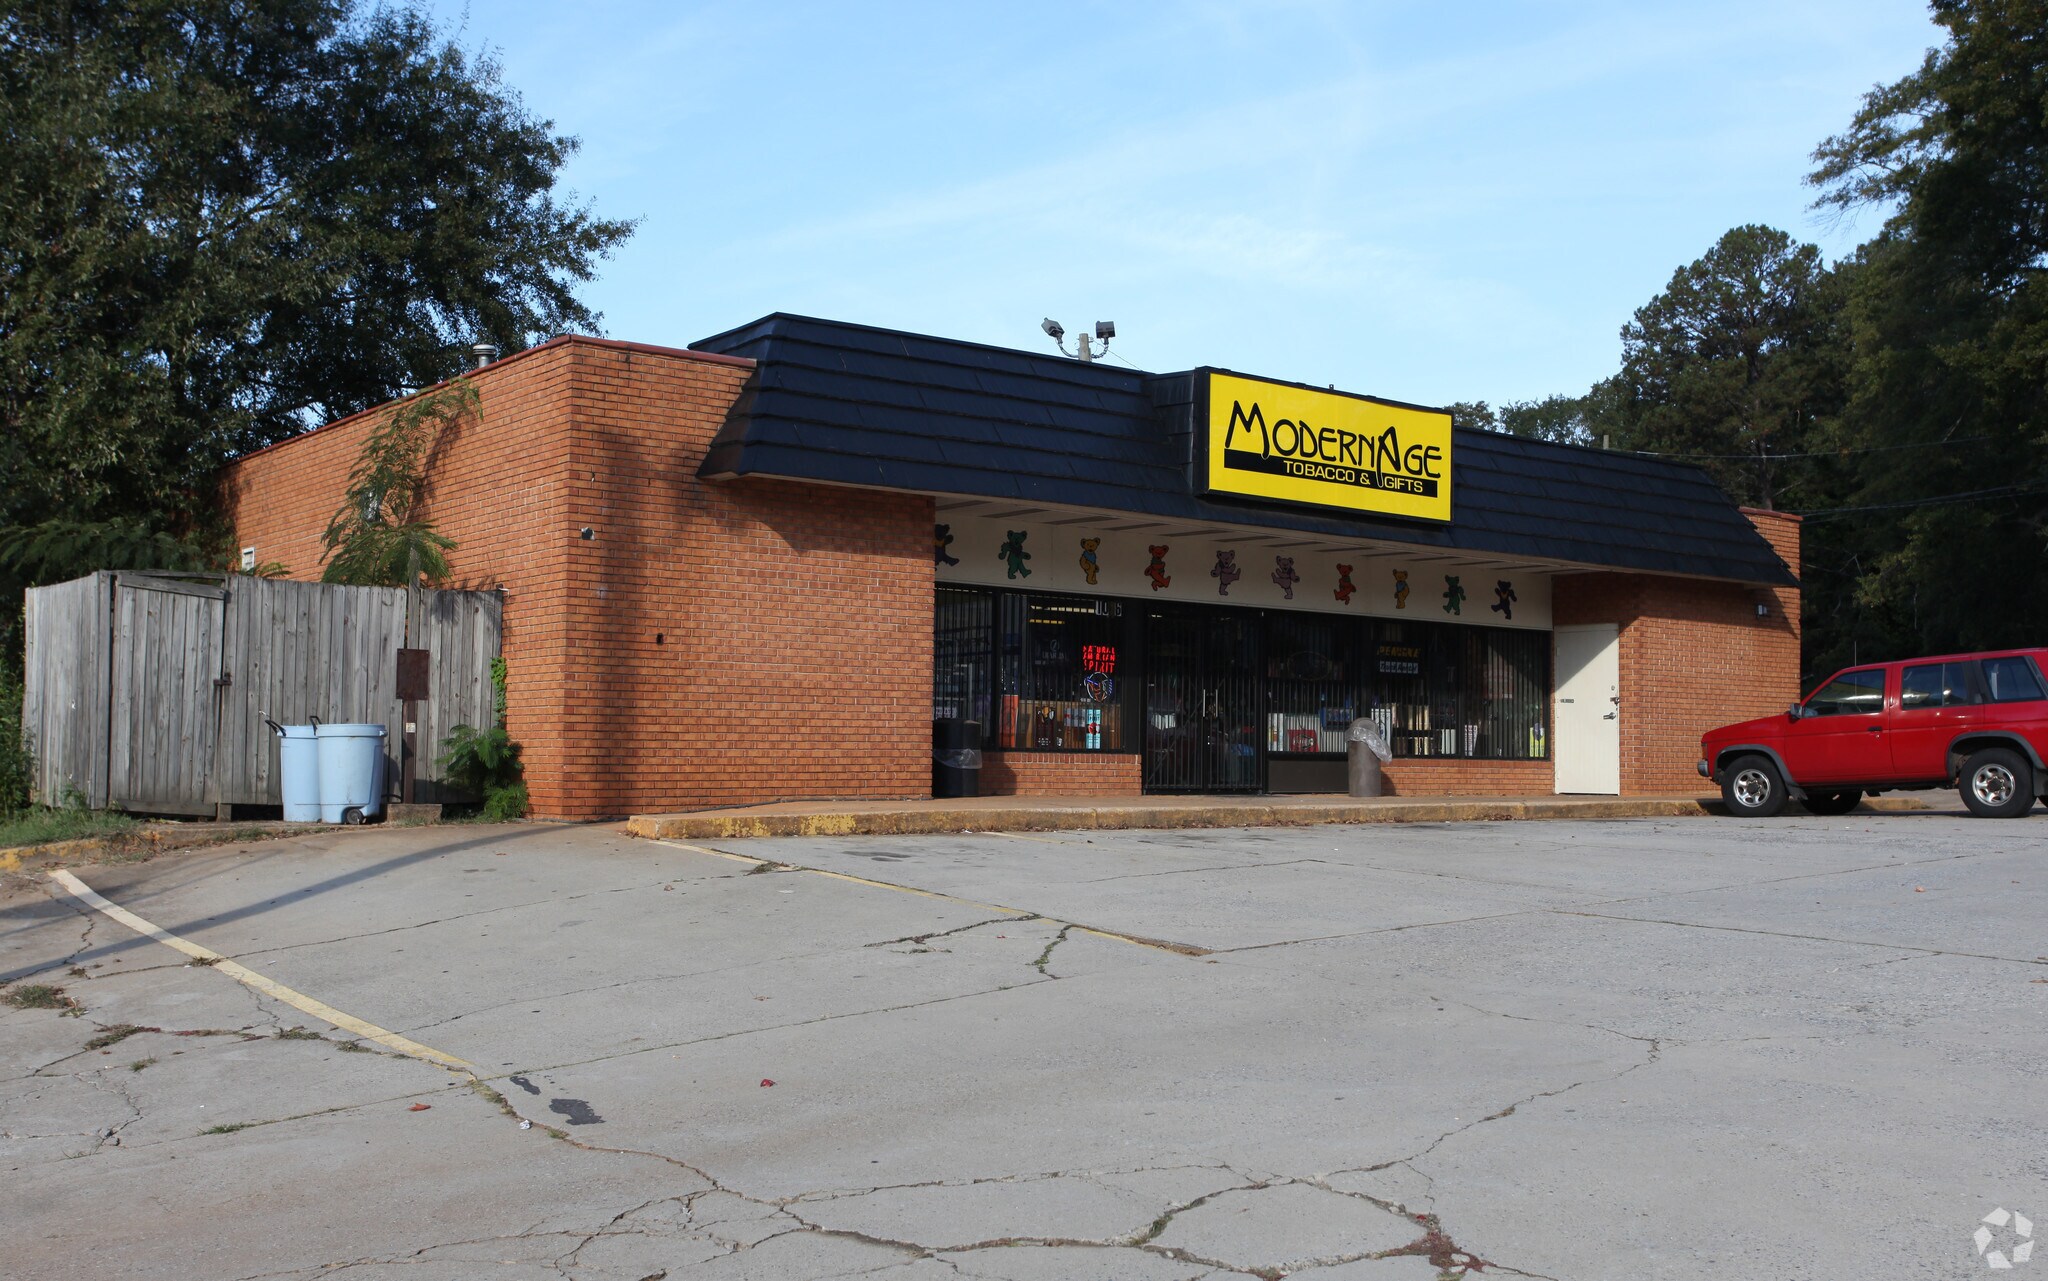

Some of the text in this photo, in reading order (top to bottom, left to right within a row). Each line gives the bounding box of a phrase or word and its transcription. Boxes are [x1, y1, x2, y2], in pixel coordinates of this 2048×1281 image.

[1283, 460, 1423, 493] TOBACCO & GIFTS
[1083, 645, 1115, 654] NAURAL
[1083, 652, 1116, 661] AMRCAN
[1083, 659, 1115, 673] SPIRIT
